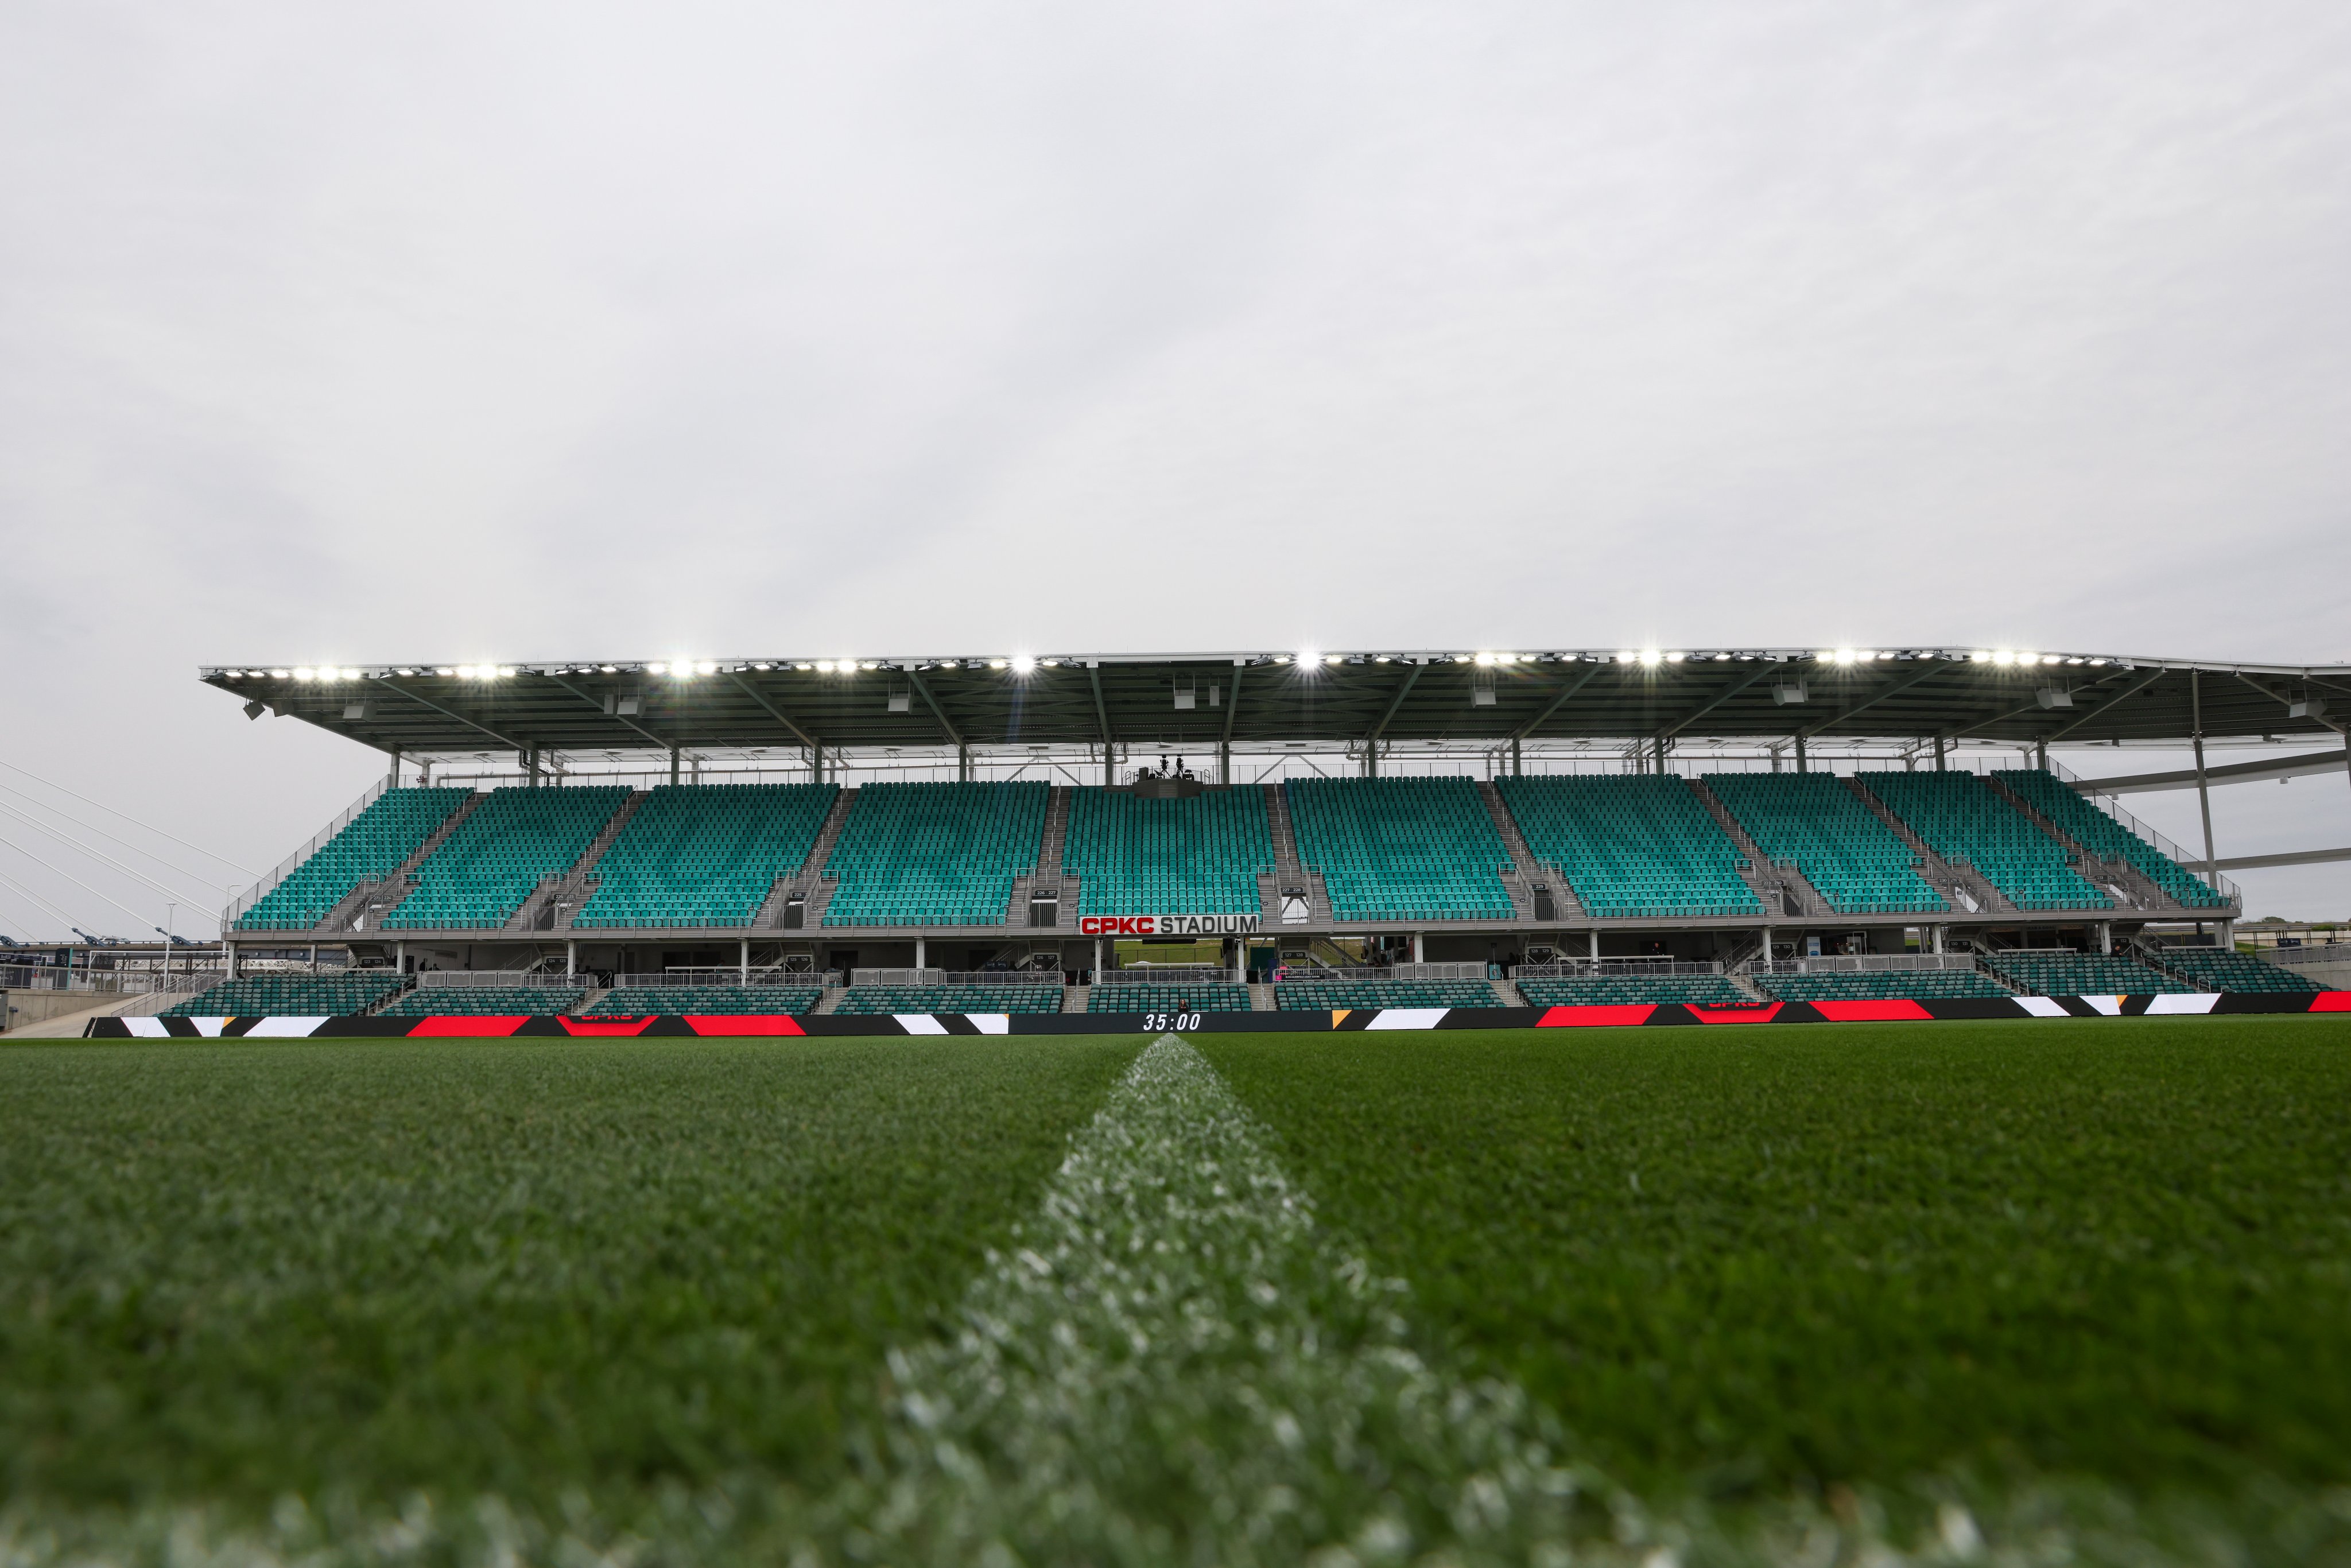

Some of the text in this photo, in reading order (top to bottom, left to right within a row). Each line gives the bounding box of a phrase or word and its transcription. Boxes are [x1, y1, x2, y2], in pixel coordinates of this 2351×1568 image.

[1081, 915, 1257, 934] CPKC STADIUM
[1143, 1013, 1201, 1031] 35:00
